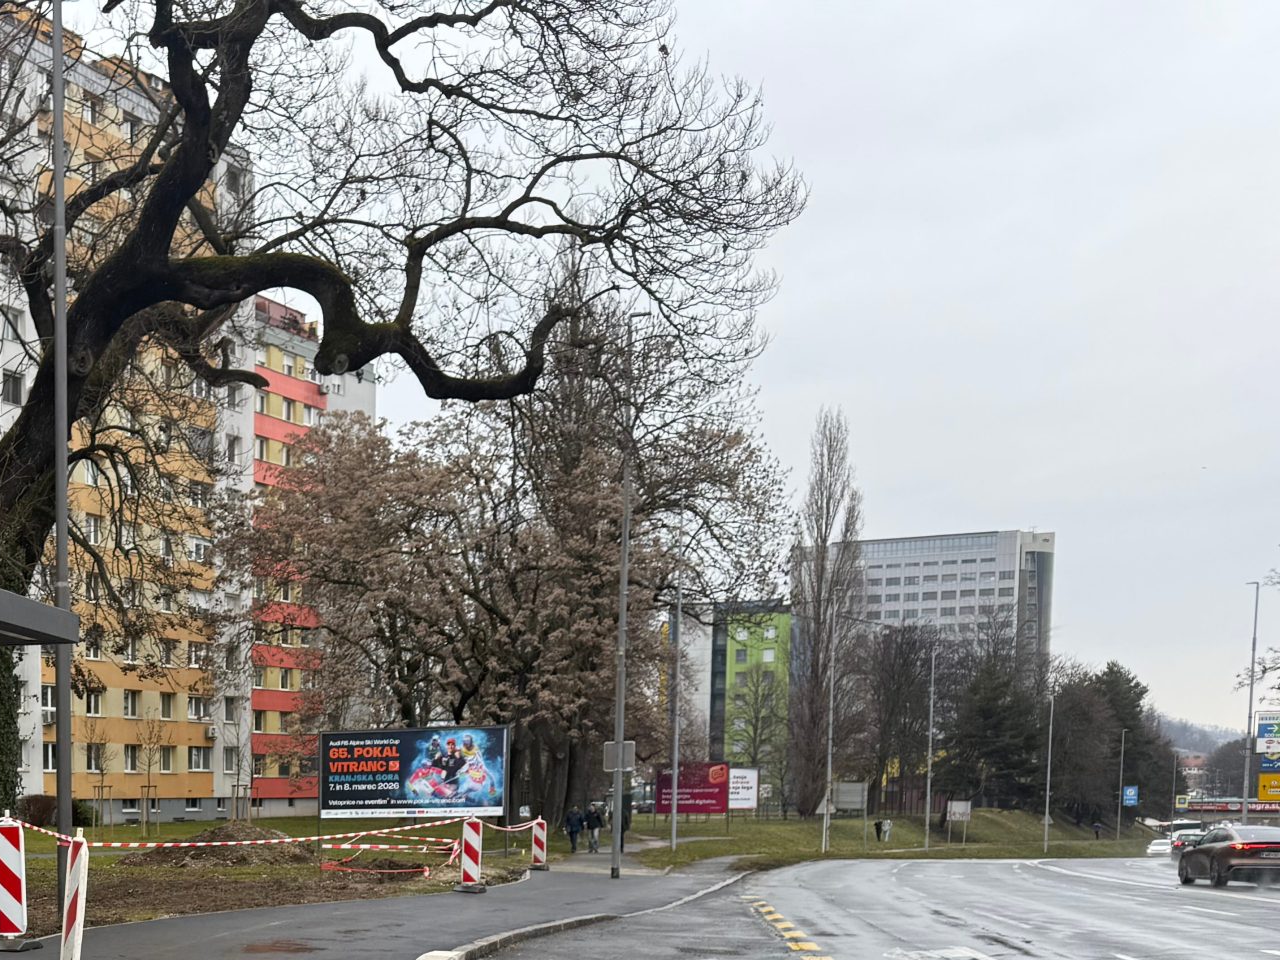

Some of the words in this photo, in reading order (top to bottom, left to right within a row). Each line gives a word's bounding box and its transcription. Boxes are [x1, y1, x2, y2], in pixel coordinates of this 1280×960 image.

[329, 747, 351, 759] 65.
[353, 746, 400, 758] POKAL
[329, 761, 387, 773] VITRANC
[328, 774, 373, 782] KRANJSKA
[375, 773, 400, 781] GORA
[328, 783, 335, 791] 7.
[336, 783, 343, 791] in
[343, 783, 351, 791] 8.
[377, 782, 400, 790] 2026
